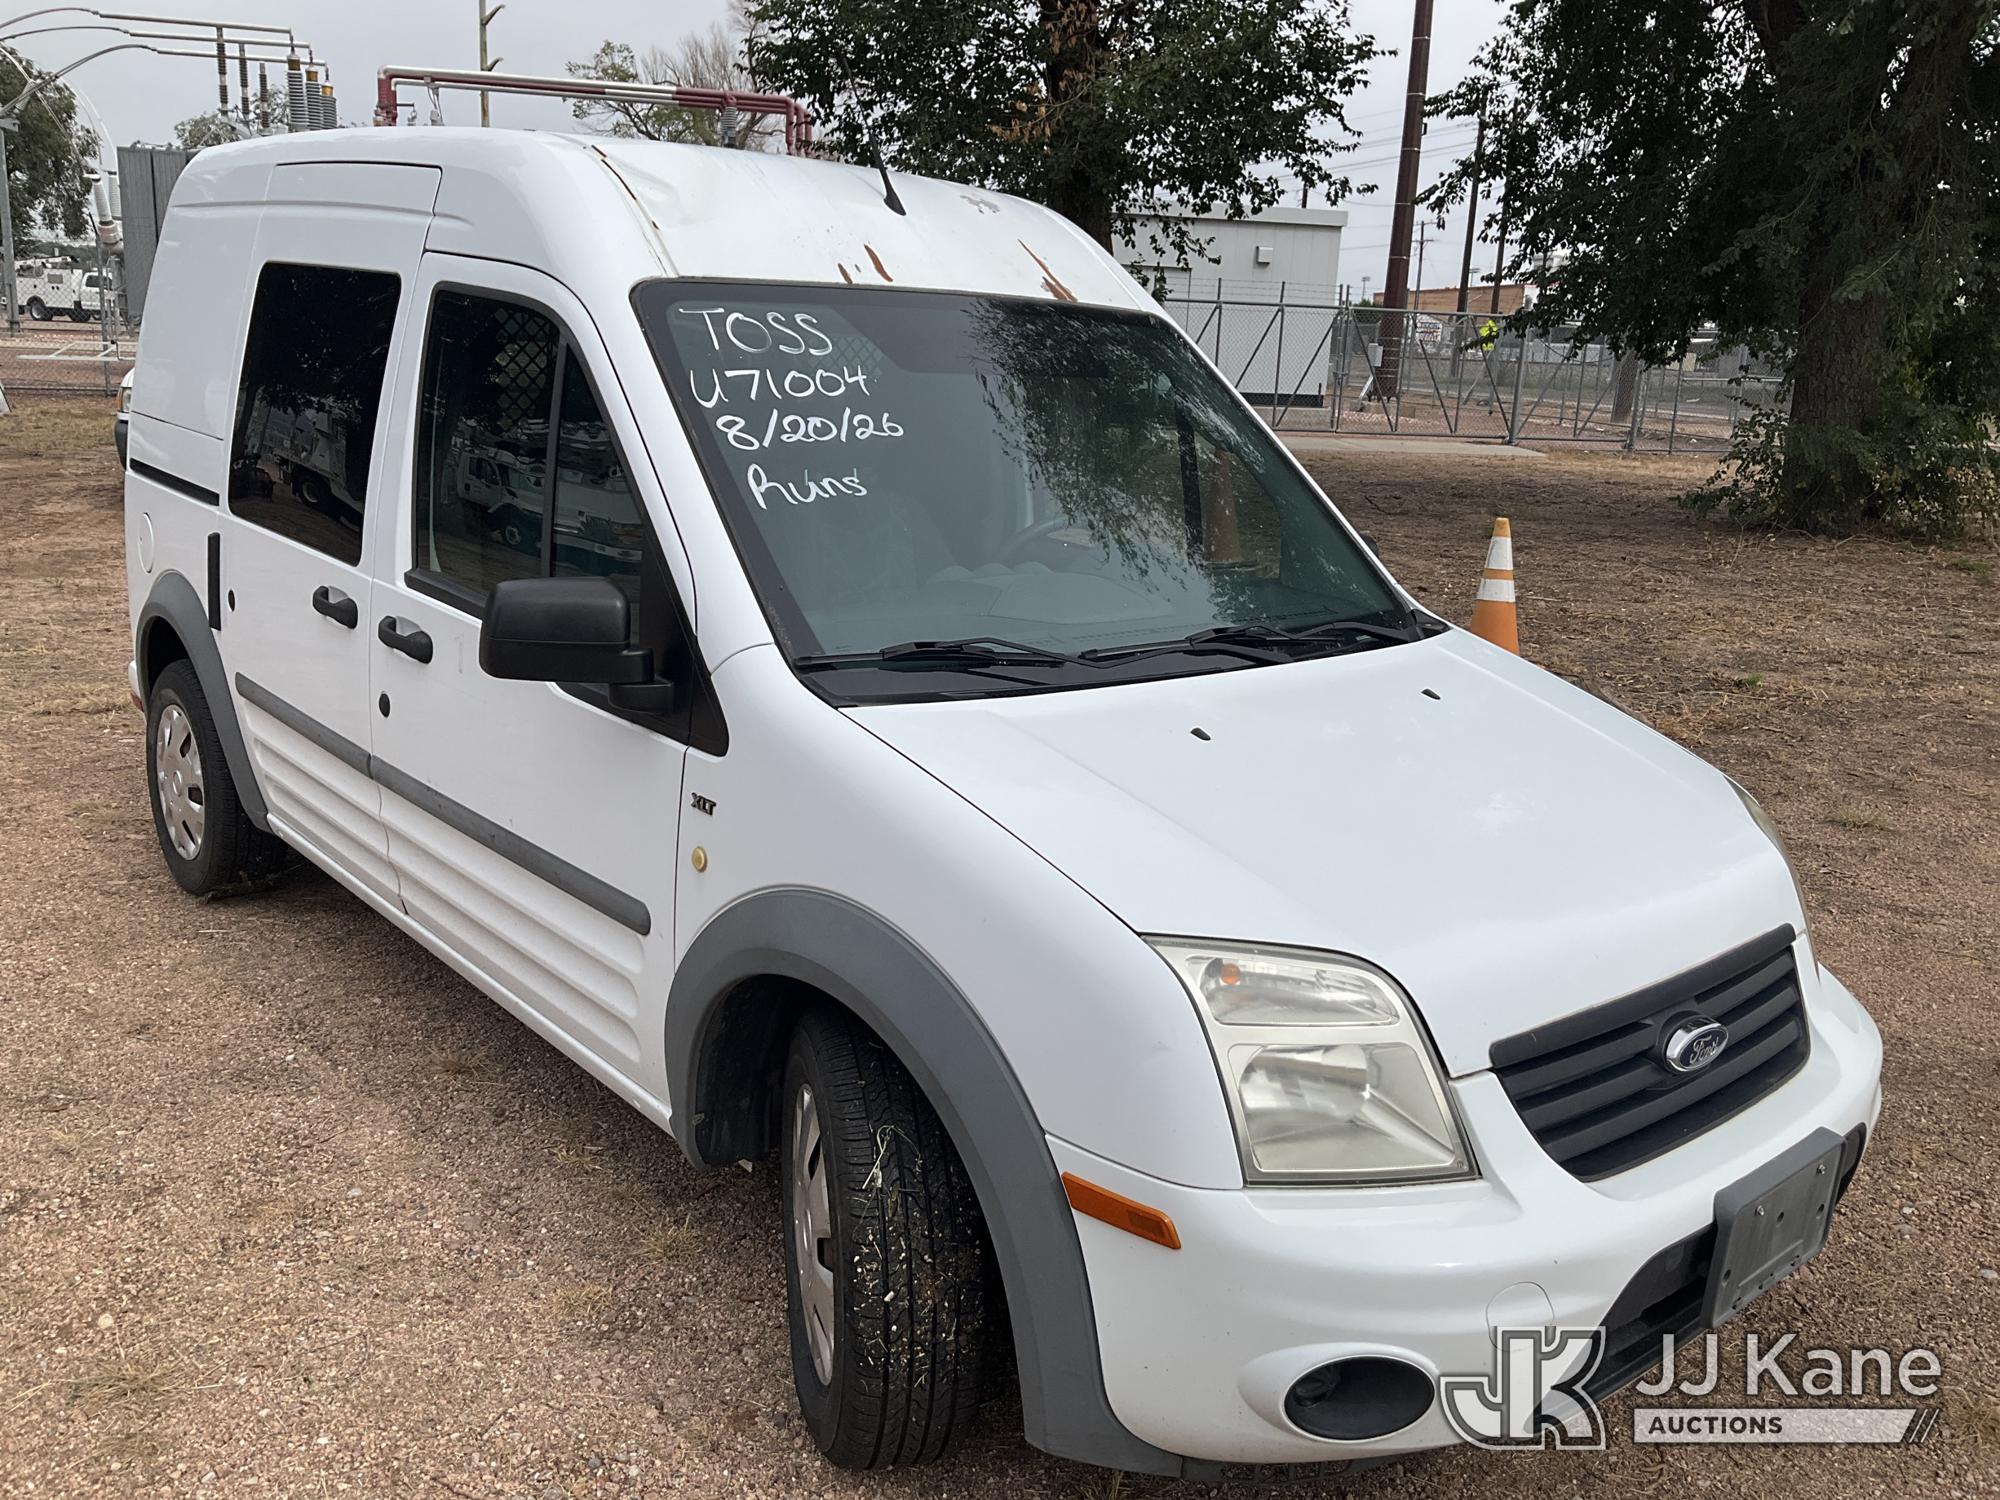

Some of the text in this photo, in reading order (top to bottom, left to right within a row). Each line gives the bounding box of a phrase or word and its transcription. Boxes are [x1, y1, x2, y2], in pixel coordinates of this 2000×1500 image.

[678, 308, 833, 356] TOSS
[690, 365, 871, 408] U71004
[715, 406, 904, 451] 8/20/26
[747, 463, 868, 510] Runs
[691, 792, 717, 816] XLT
